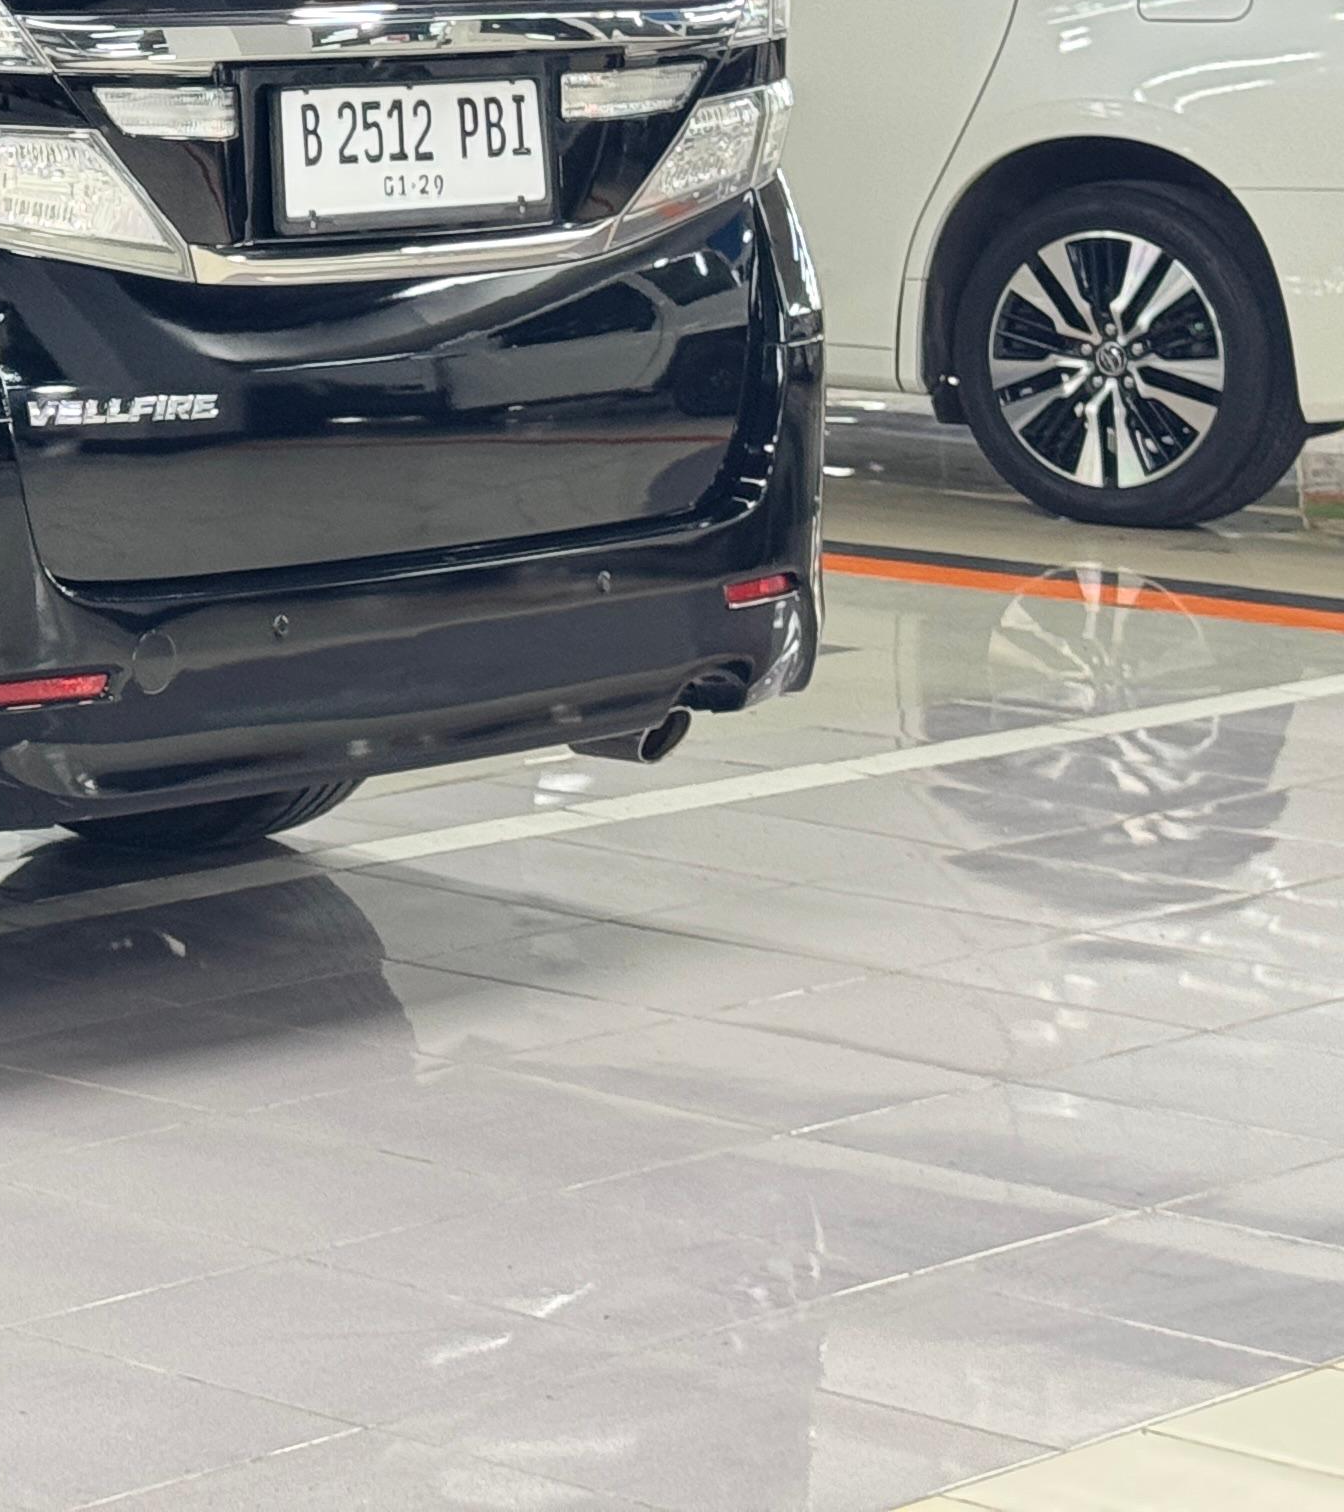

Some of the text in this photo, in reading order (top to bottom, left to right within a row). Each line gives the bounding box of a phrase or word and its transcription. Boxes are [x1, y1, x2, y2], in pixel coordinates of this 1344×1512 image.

[300, 94, 532, 167] B 2512 PBI
[26, 393, 220, 427] VELLFIRE
